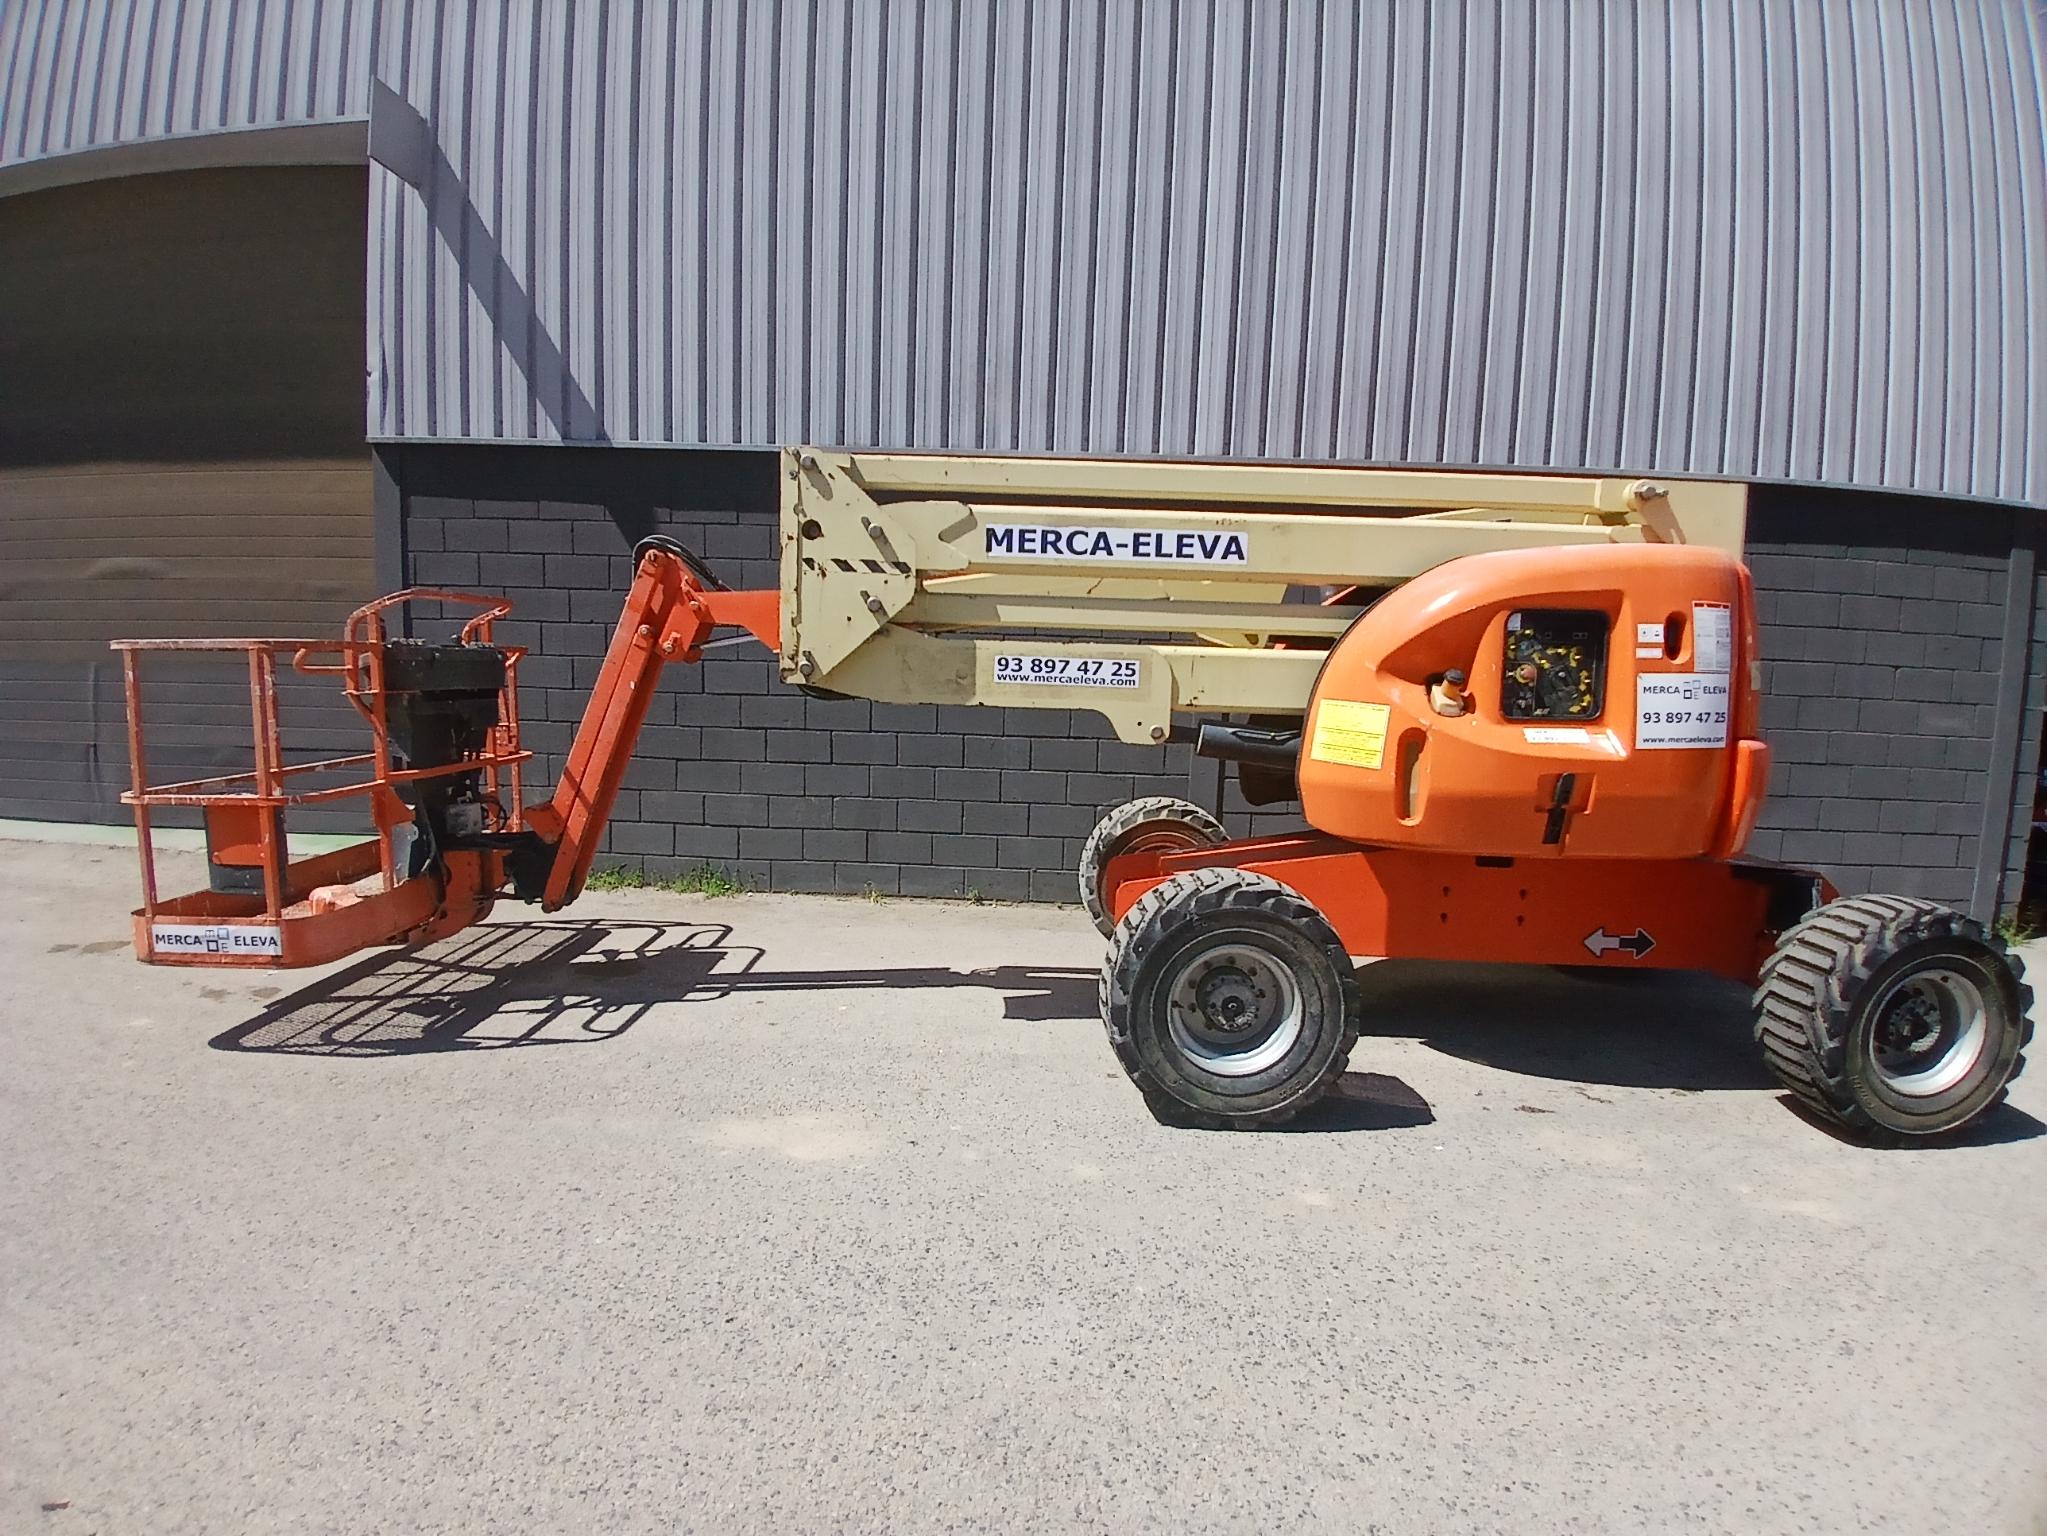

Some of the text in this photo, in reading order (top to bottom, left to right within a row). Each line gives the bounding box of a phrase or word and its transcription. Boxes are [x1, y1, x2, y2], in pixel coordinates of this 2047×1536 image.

[985, 527, 1246, 561] MERCA-ELEVA
[997, 657, 1137, 678] 93 897 47 25
[996, 673, 1136, 686] www.mercaeleva.com
[1642, 685, 1727, 695] MERCA ELEVA
[1642, 712, 1726, 724] 93 897 47 25
[155, 934, 278, 947] MERCA ELEVA
